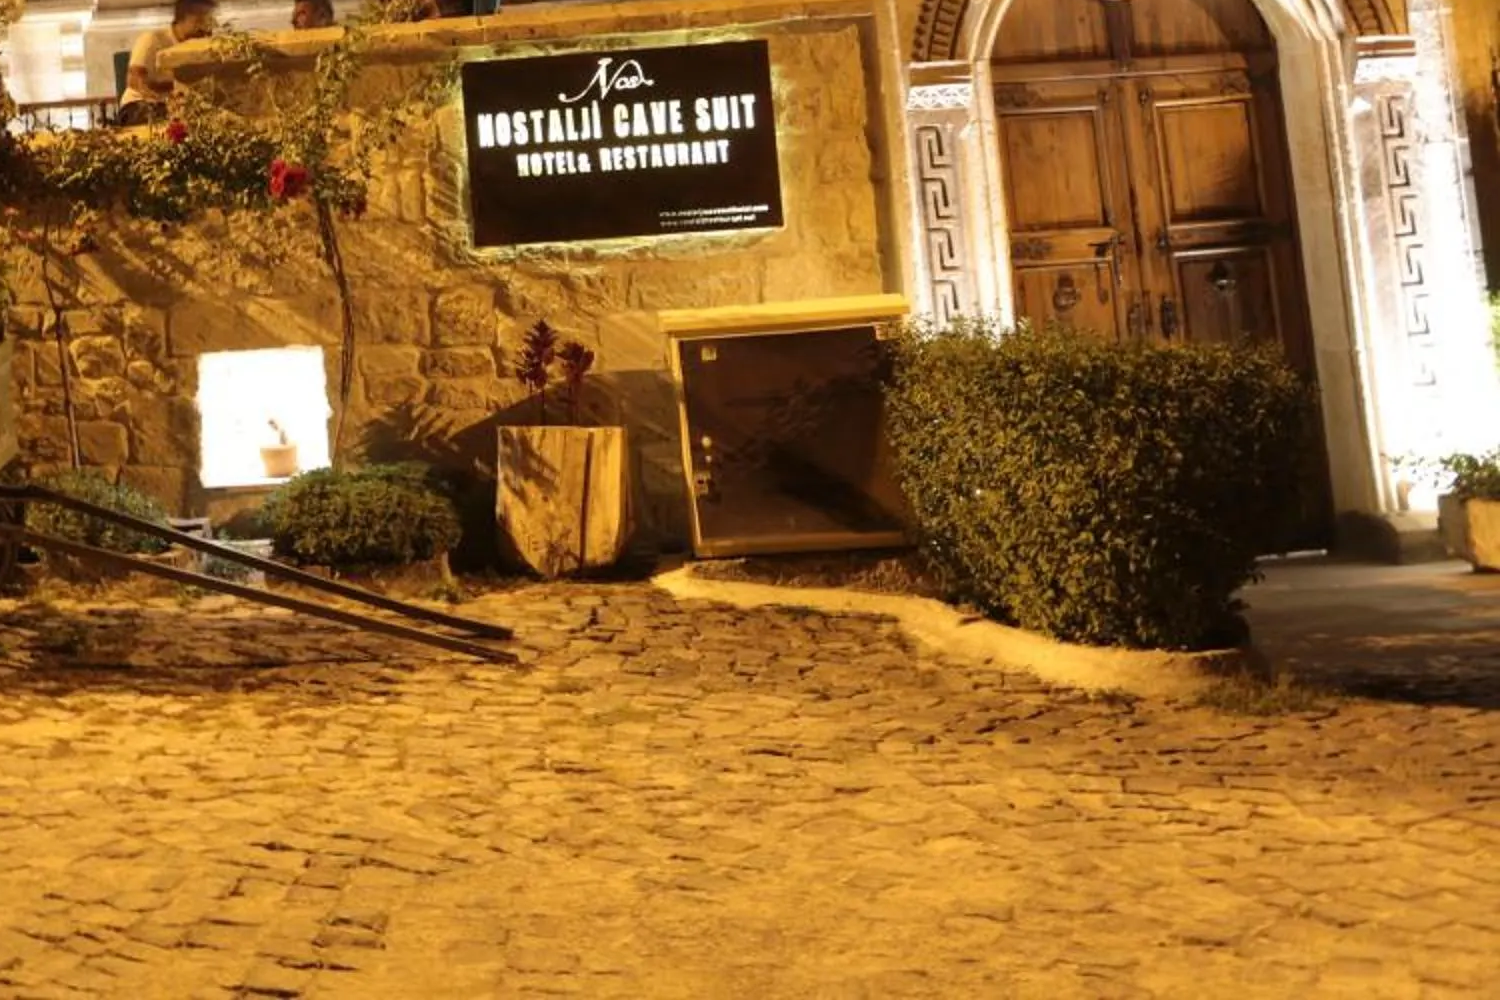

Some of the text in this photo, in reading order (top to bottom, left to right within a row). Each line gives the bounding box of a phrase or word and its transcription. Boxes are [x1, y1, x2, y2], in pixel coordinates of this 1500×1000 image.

[612, 100, 683, 138] CAVE
[695, 93, 756, 133] SUIT
[600, 139, 729, 172] RESTAURANT
